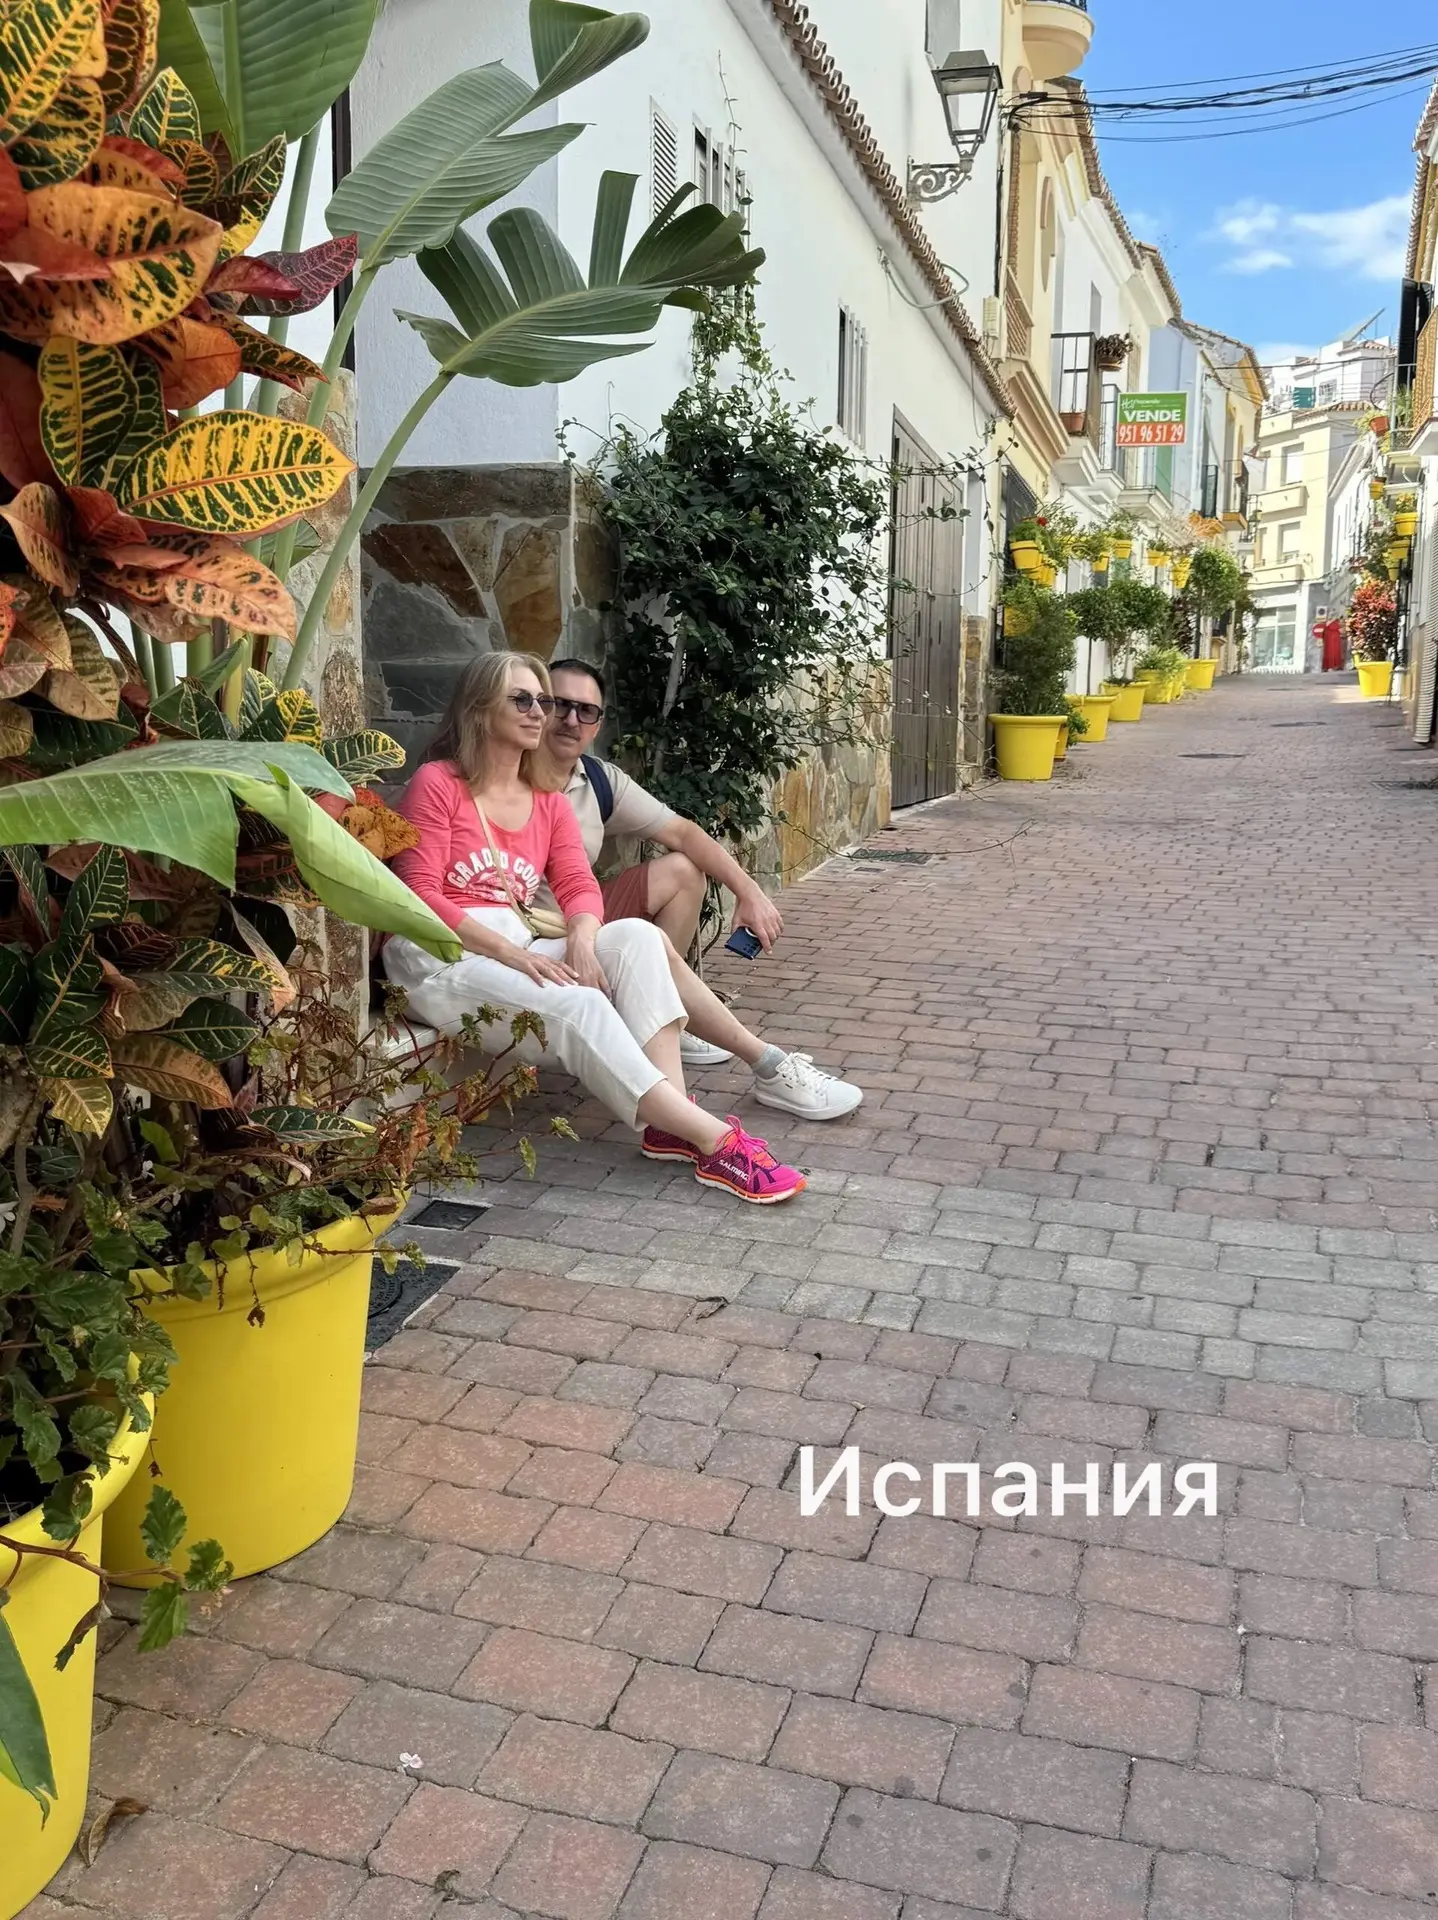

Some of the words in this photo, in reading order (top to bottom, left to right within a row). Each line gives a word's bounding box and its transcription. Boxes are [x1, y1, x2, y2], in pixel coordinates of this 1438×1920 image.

[1123, 409, 1181, 422] VENDE
[1119, 424, 1137, 442] 951
[1140, 424, 1153, 442] 96
[1155, 424, 1167, 442] 51
[1170, 423, 1184, 442] 29
[447, 847, 509, 888] GRADD
